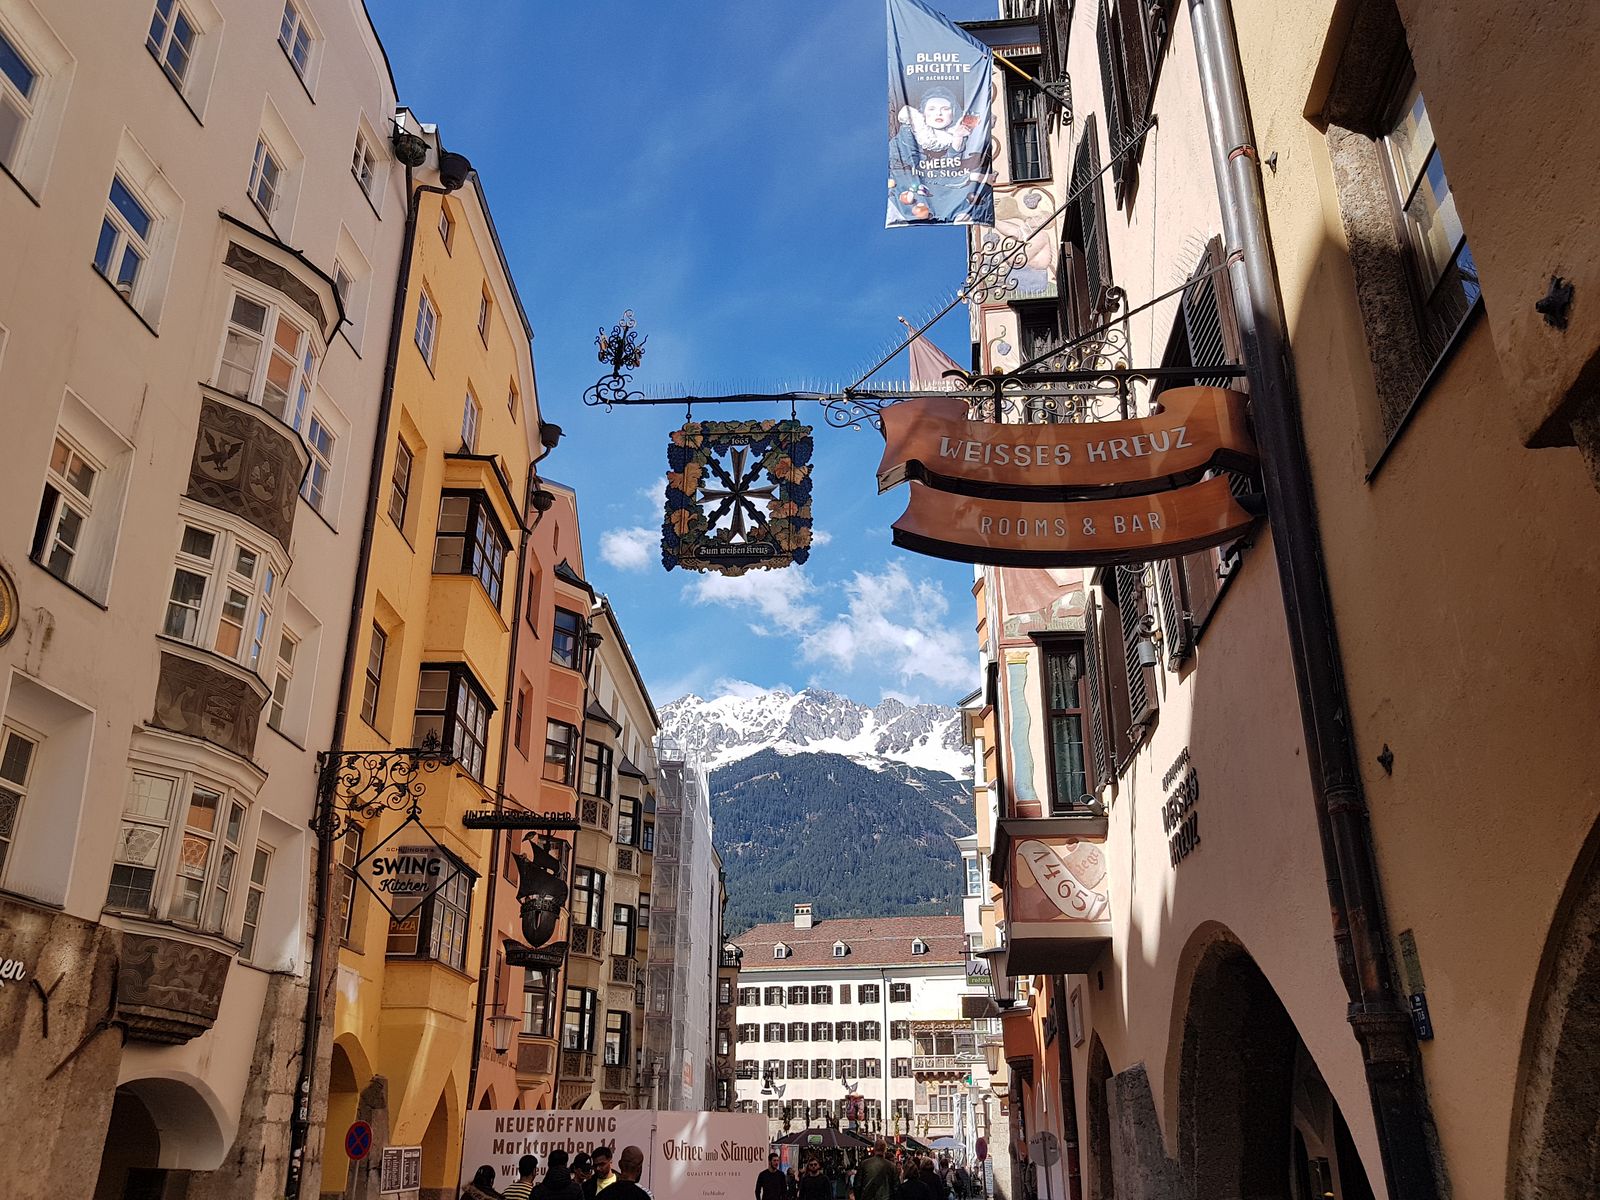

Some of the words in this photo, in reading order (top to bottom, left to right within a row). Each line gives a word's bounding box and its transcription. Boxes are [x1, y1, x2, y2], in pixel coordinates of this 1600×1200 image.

[916, 52, 960, 63] BLAUE
[906, 63, 971, 76] BRIGITTE
[919, 156, 962, 170] CHEERS
[940, 167, 971, 178] Stock
[731, 437, 749, 445] 1665
[938, 435, 1072, 466] WEISSES
[1087, 426, 1193, 463] KREUZ
[981, 516, 1066, 537] ROOMS
[1082, 517, 1097, 536] &
[1113, 511, 1162, 534] BAR
[700, 546, 719, 555] Zum
[372, 857, 441, 876] SWING
[379, 878, 430, 895] Kitchen
[390, 920, 416, 931] PIZZA
[0, 956, 26, 981] en
[495, 1113, 617, 1133] NEUERÖFFNUNG
[492, 1138, 594, 1159] Marktgraben
[705, 1148, 719, 1161] und
[720, 1139, 765, 1164] Stanger
